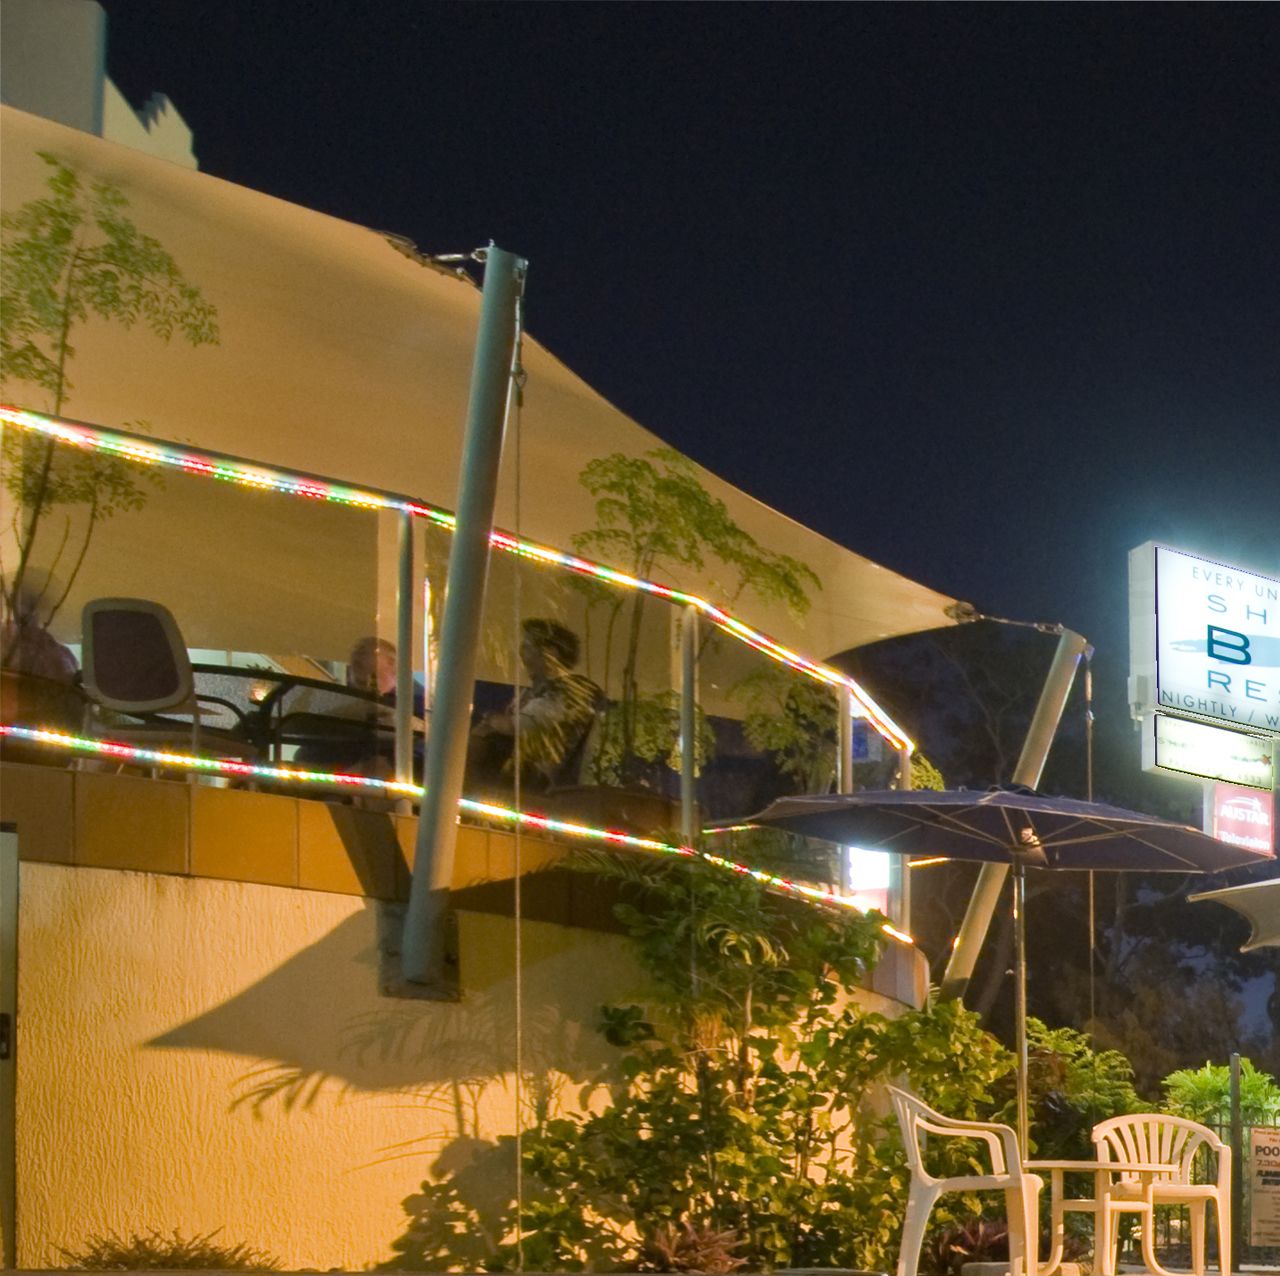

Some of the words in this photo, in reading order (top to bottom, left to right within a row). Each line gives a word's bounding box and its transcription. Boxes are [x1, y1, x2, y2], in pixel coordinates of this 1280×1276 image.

[1192, 566, 1244, 590] EVERY
[1162, 690, 1237, 718] NIGHTLY
[1220, 804, 1269, 826] AUSTAR
